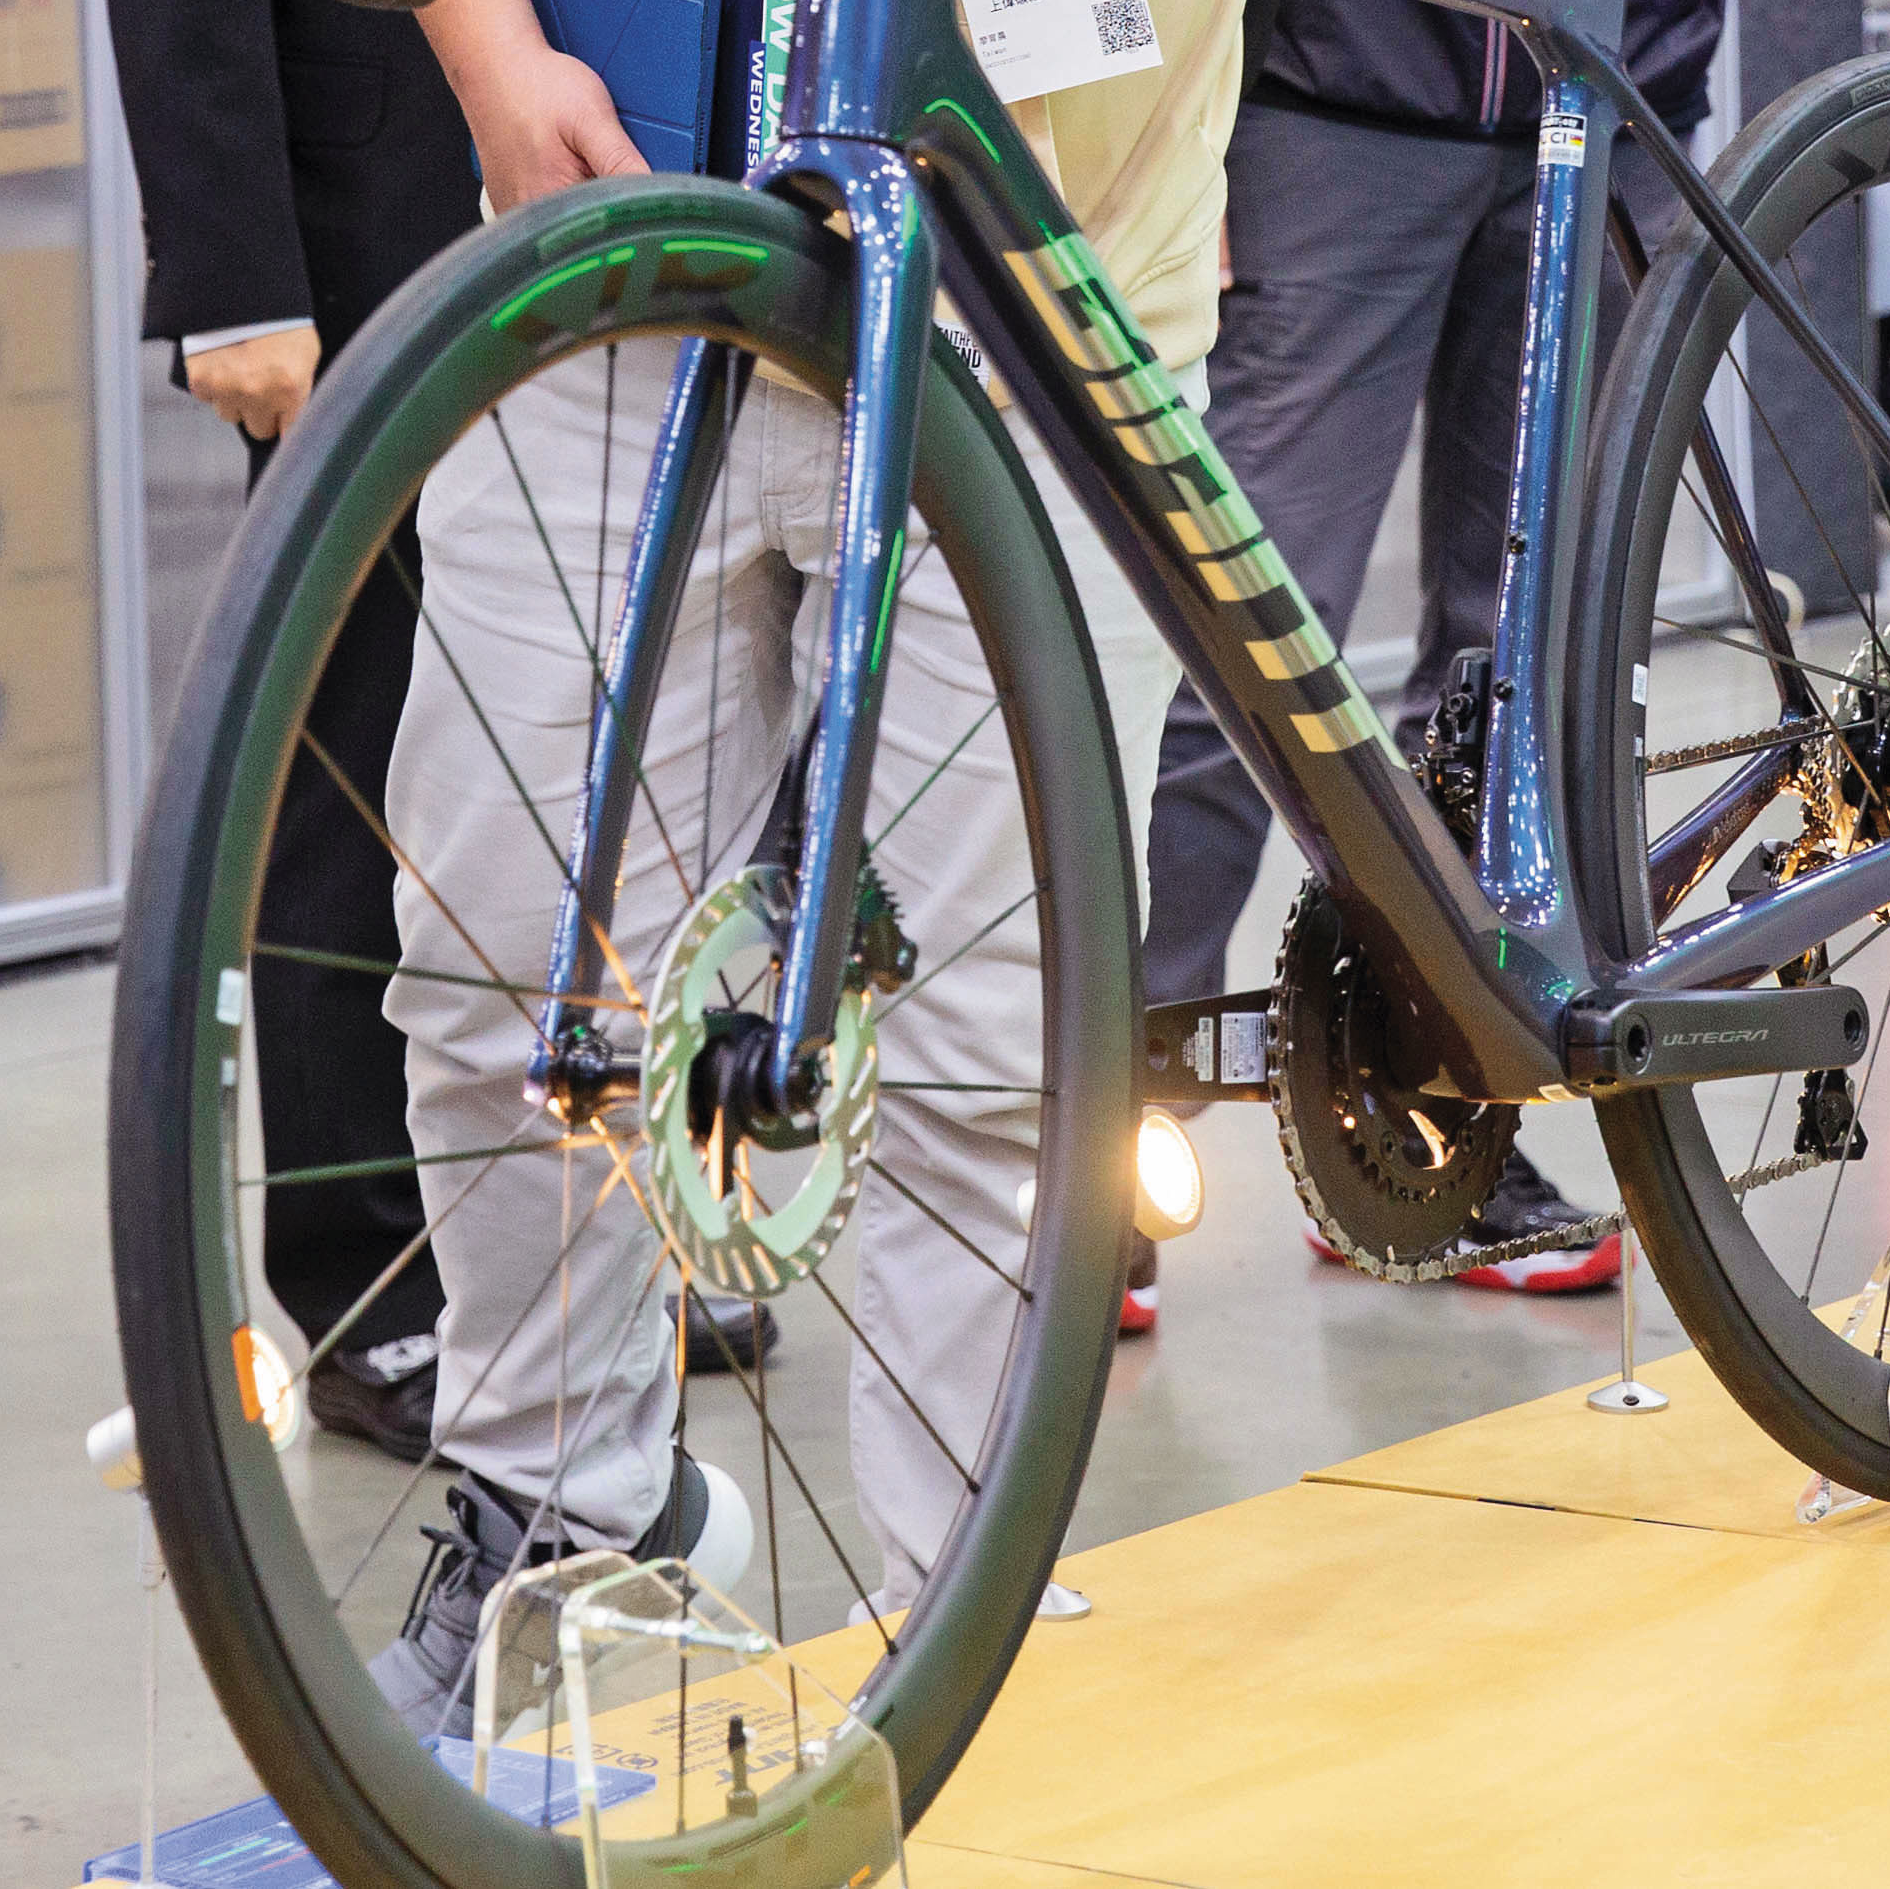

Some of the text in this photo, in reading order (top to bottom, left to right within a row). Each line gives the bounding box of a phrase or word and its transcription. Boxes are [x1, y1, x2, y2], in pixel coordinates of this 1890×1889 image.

[746, 49, 765, 176] WEDNES
[763, 72, 787, 158] DA
[1002, 231, 1410, 772] GIANT
[1661, 1027, 1770, 1049] ULTEGRA
